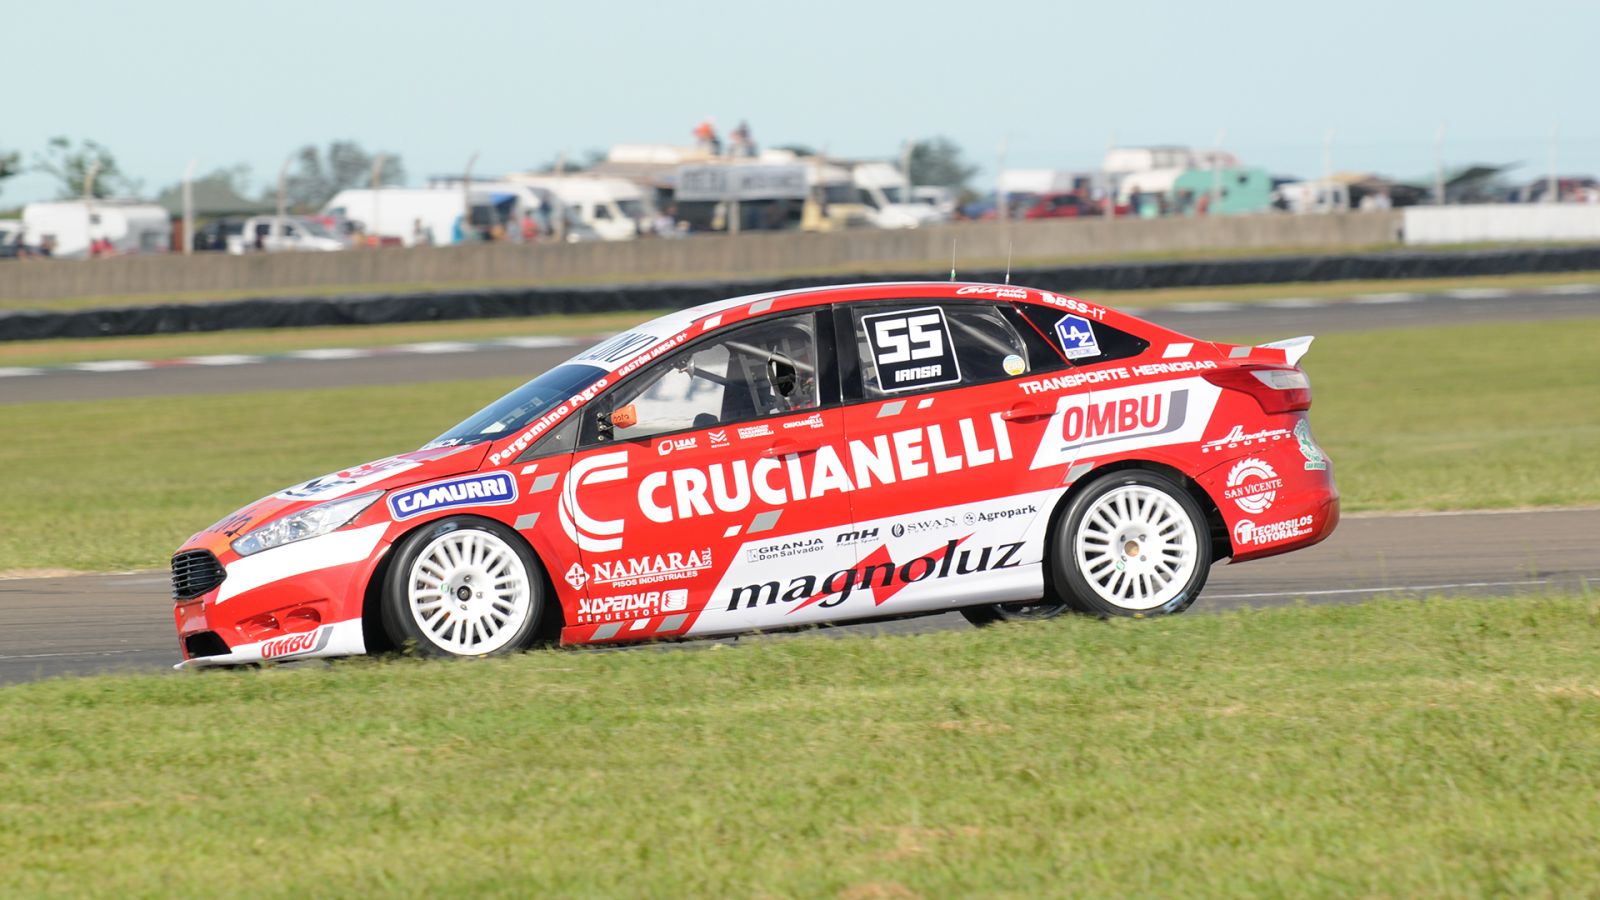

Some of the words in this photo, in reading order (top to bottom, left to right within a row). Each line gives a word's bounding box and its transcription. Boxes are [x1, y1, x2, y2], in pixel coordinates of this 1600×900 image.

[875, 314, 943, 365] 55
[1060, 324, 1094, 347] LAZ
[618, 353, 652, 376] GASTÓN
[651, 339, 677, 358] IANSA
[895, 364, 942, 383] IANSA
[1019, 367, 1130, 395] TRANSPORTE
[1134, 360, 1218, 377] HERNORAR
[489, 405, 569, 466] Pergamino
[568, 378, 608, 407] Agro
[1061, 393, 1162, 442] OMBU
[674, 437, 697, 448] LEAF
[637, 412, 1013, 525] CRUCIANELLI
[397, 472, 508, 513] CAMURRI
[1224, 487, 1244, 499] SAN
[1244, 478, 1284, 497] VICENTE
[907, 516, 956, 531] SWAN
[977, 504, 1037, 523] Agropark
[1251, 515, 1313, 536] TECNOSILOS
[1254, 528, 1298, 545] TOTORAS
[758, 538, 824, 554] GRANJA
[759, 552, 779, 561] Don
[780, 545, 825, 557] Salvador
[592, 549, 704, 581] NAMARA
[702, 547, 713, 566] SRL
[725, 538, 1027, 611] magnoluz
[612, 579, 638, 589] PISOS
[639, 570, 698, 585] INDUSTRIALES
[577, 607, 659, 623] REPUESTOS
[260, 630, 318, 659] OMBU
